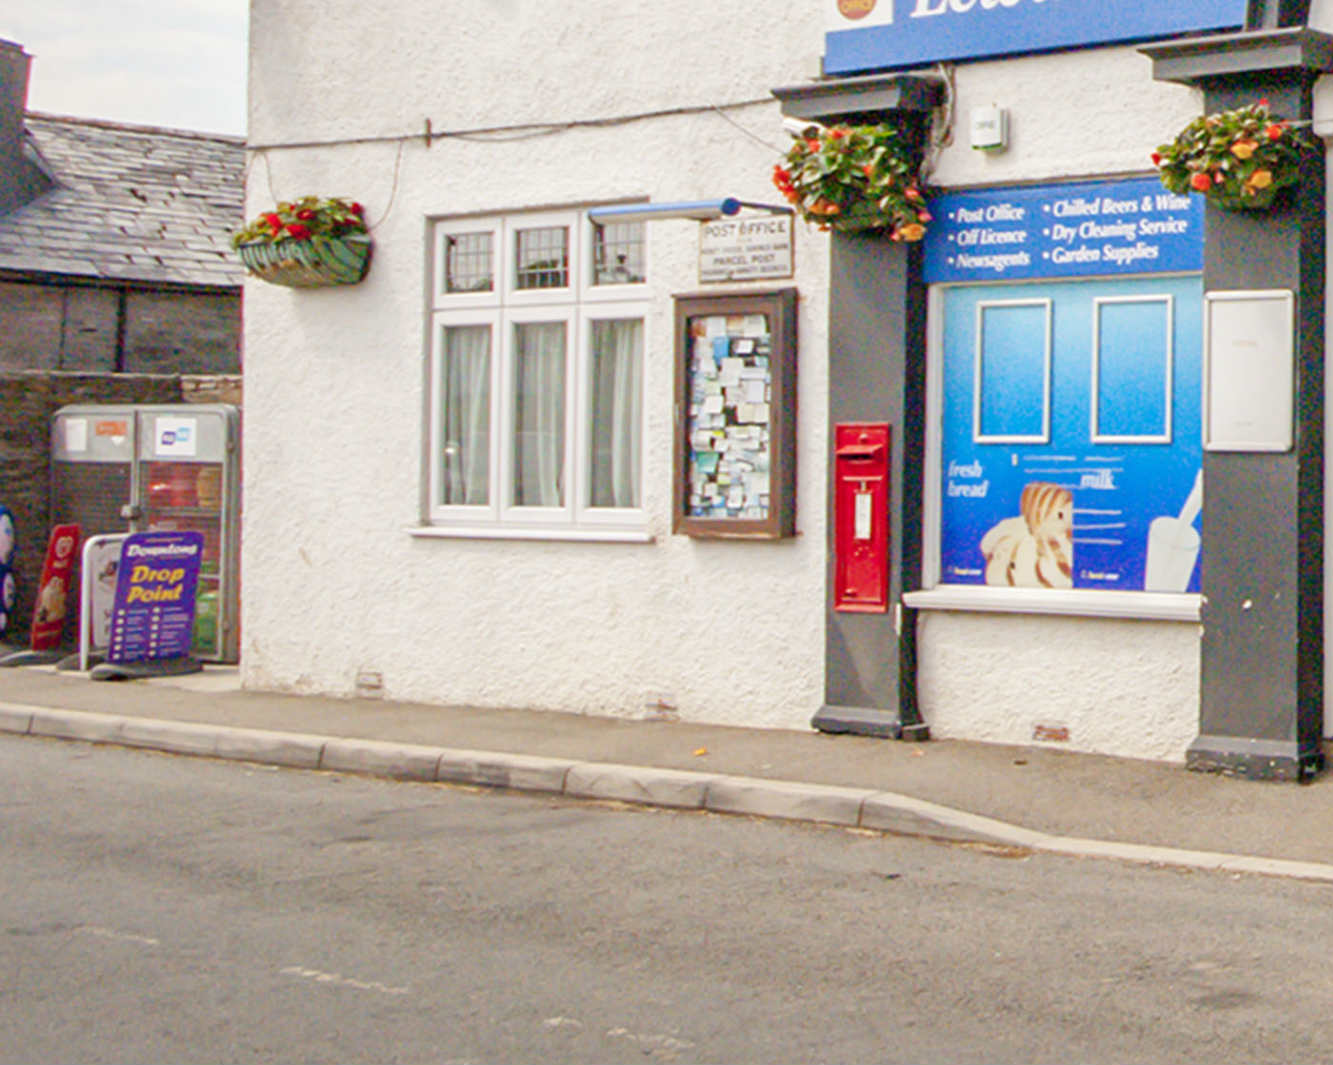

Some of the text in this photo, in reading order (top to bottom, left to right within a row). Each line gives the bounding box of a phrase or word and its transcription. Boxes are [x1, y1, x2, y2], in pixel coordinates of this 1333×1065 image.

[956, 203, 1025, 222] Post Office
[1053, 194, 1191, 217] Chilled Beers & Wine
[704, 219, 787, 238] POST OFFICE
[957, 229, 1027, 246] Off Licence
[1051, 215, 1188, 244] Dry Cleaning Service
[955, 252, 1030, 271] Newsagents
[1051, 242, 1159, 265] Garden Supplies
[948, 459, 983, 477] fresh
[947, 479, 989, 498] bread
[1080, 469, 1116, 490] milk
[130, 565, 185, 585] Drop
[126, 583, 183, 603] Point
